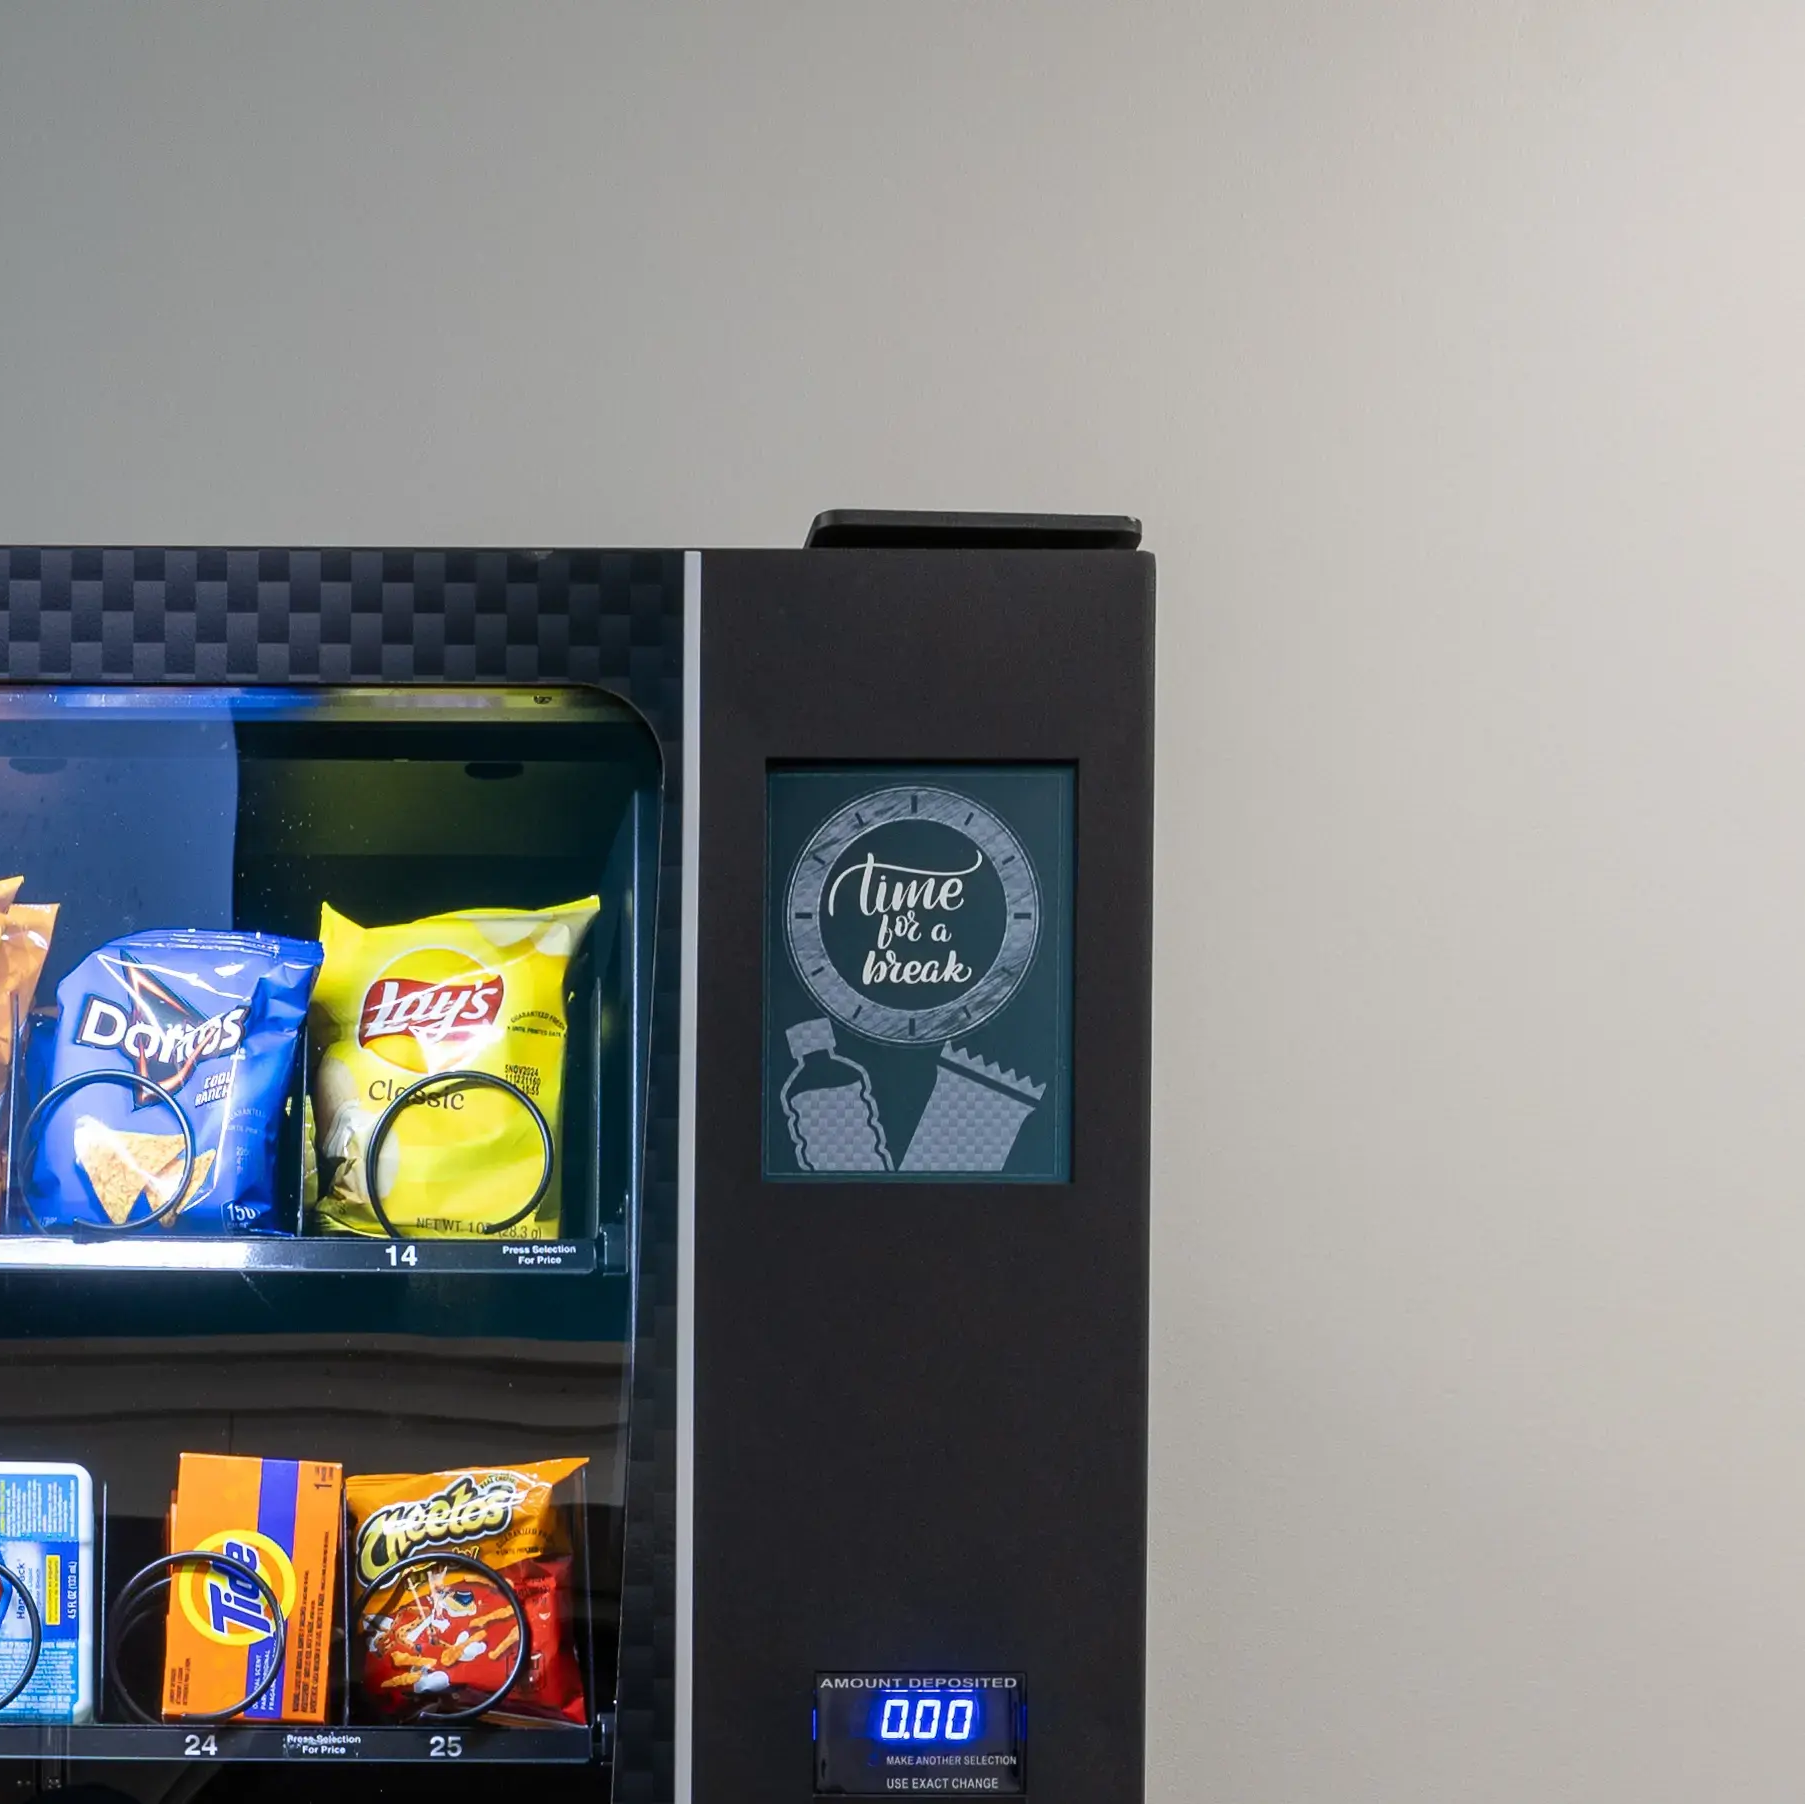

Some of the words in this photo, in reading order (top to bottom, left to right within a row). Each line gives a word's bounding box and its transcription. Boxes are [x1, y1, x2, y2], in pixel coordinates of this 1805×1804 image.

[829, 850, 983, 917] time
[878, 911, 922, 949] for
[931, 924, 952, 942] a
[862, 950, 972, 985] break
[364, 981, 499, 1044] Lay's
[81, 999, 248, 1064] Doritos
[416, 1217, 440, 1229] NET
[498, 1226, 529, 1240] (28.3
[385, 1245, 418, 1266] 14
[502, 1245, 530, 1255] Press
[531, 1245, 577, 1255] Selection
[518, 1255, 535, 1265] For
[536, 1255, 562, 1265] Price
[358, 1476, 518, 1583] Cheetos
[207, 1541, 277, 1638] Tide
[820, 1677, 903, 1688] AMOUNT
[909, 1677, 1017, 1688] DEPOSITED
[880, 1699, 974, 1740] 0.00
[183, 1735, 218, 1757] 24
[286, 1734, 315, 1745] Press
[316, 1734, 362, 1745] Selection
[301, 1745, 318, 1755] For
[319, 1745, 346, 1755] Price
[429, 1736, 463, 1757] 25
[886, 1755, 914, 1765] MAKE
[916, 1755, 961, 1765] ANOTHER
[964, 1755, 1017, 1766] SELECTION
[886, 1778, 909, 1789] USE
[912, 1778, 949, 1789] EXACT
[951, 1778, 999, 1789] CHANGE
